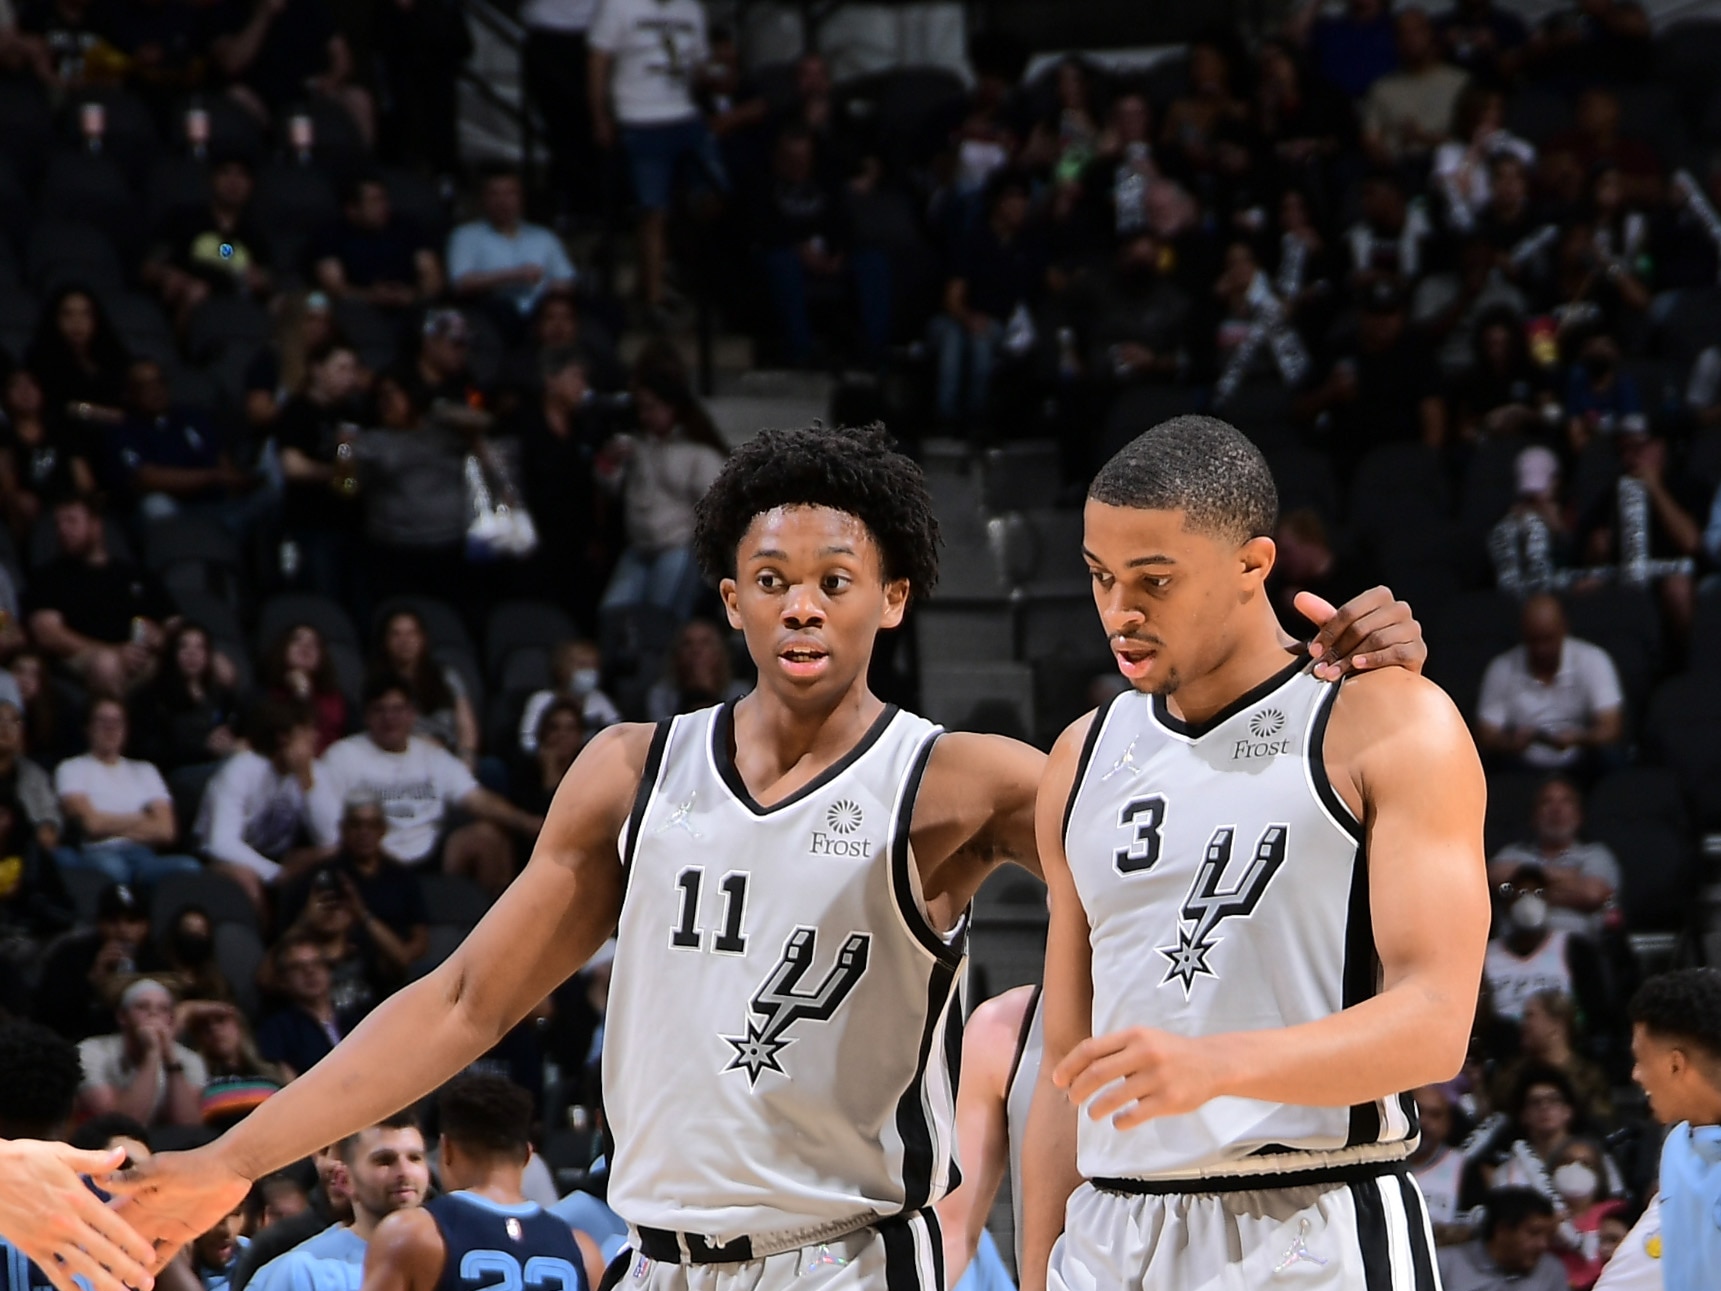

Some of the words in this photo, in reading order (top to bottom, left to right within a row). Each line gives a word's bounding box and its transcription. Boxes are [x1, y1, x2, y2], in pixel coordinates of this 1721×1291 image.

[1233, 737, 1290, 760] Frost
[809, 831, 871, 858] Frost
[1113, 792, 1168, 877] 3
[669, 866, 749, 956] 11
